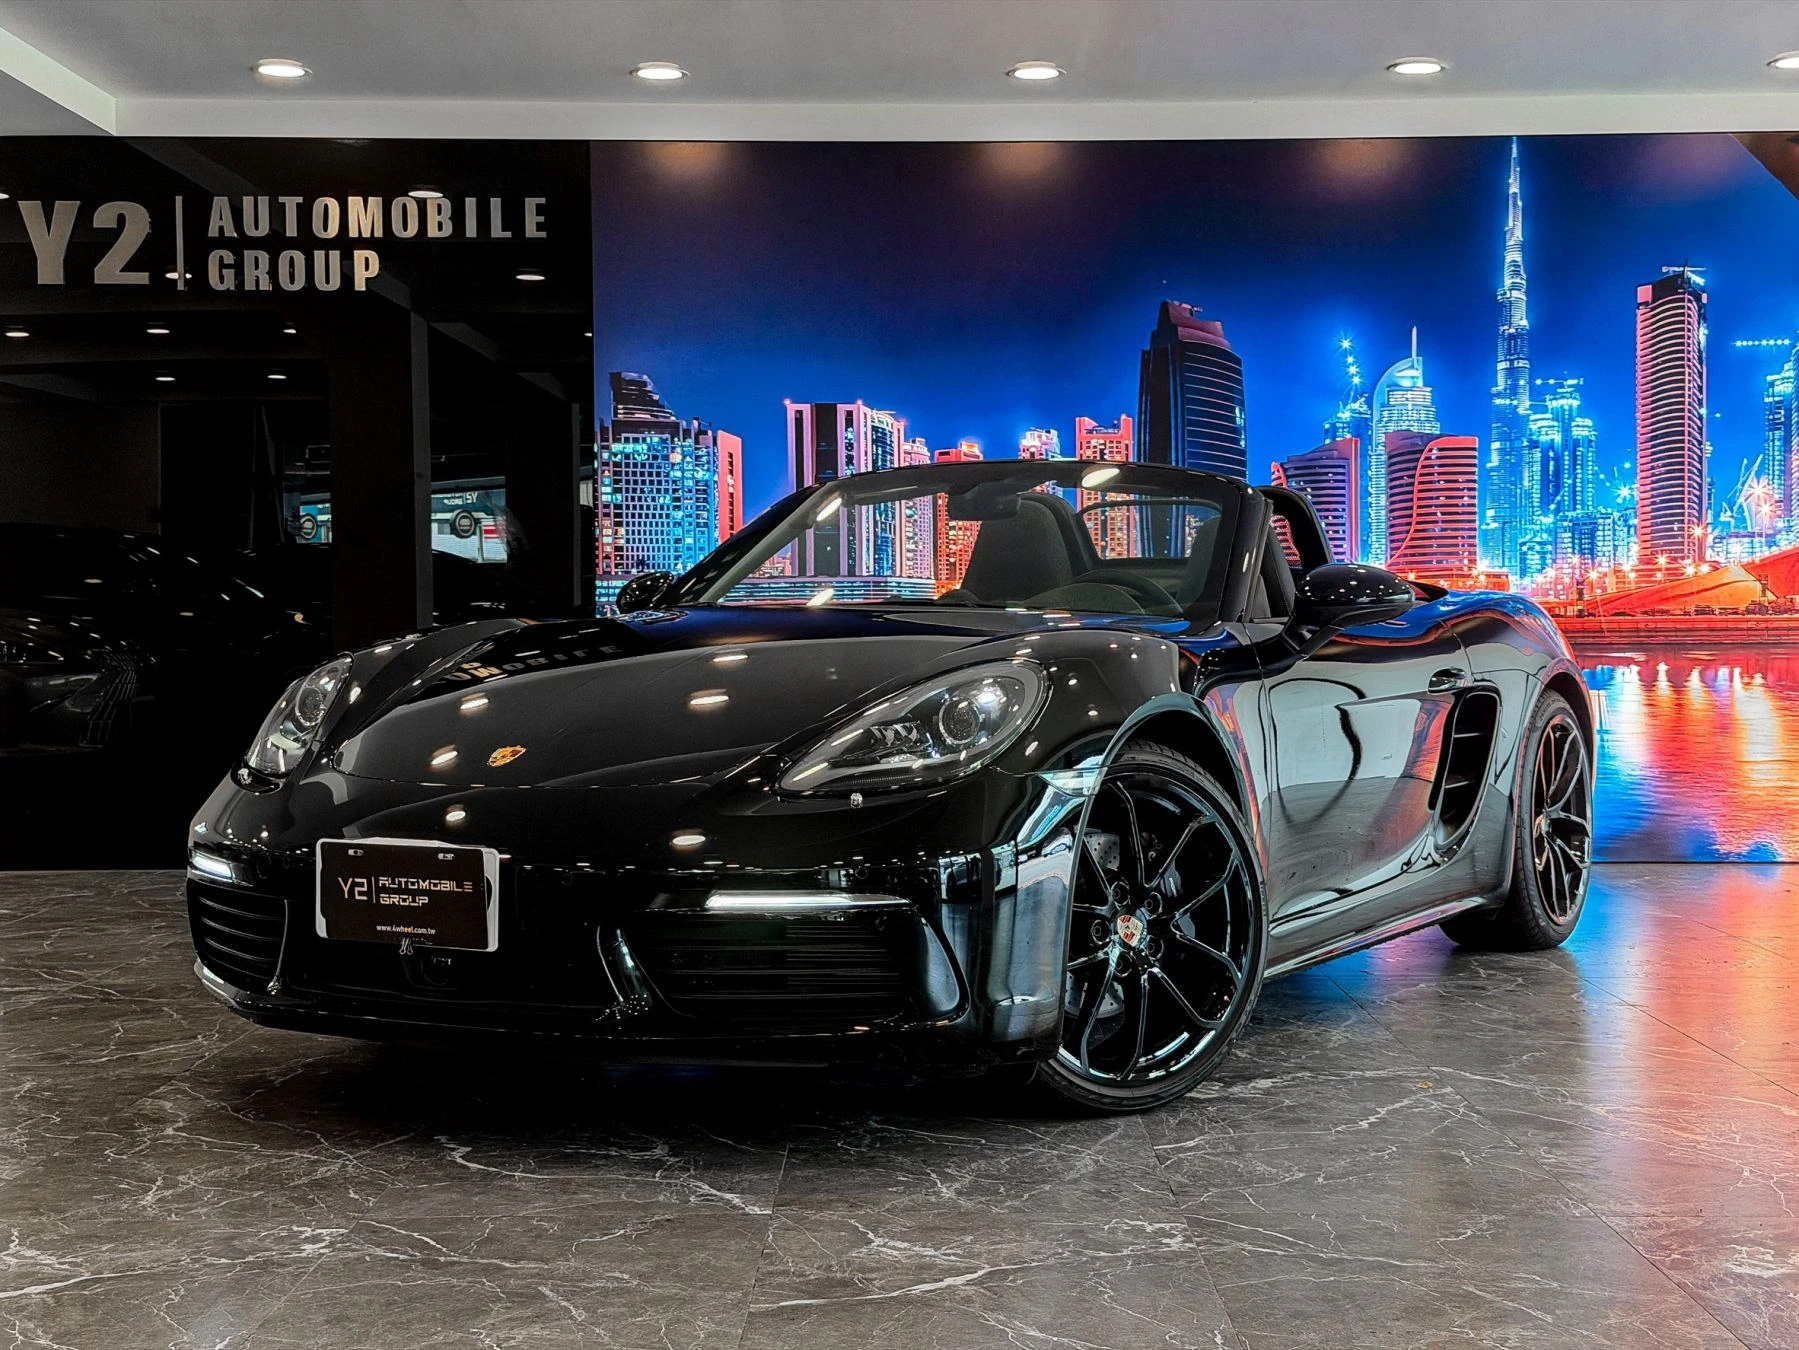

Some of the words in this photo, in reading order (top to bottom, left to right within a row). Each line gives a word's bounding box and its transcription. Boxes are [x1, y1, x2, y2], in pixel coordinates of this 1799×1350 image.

[208, 195, 547, 239] AUTOMOBILE
[18, 201, 150, 284] Y2
[208, 249, 381, 292] GROUP
[338, 876, 368, 901] Y2
[378, 876, 474, 893] AUTOMOBILE
[379, 893, 429, 907] GROUP
[376, 924, 436, 935] www.4wheel.com.tw
